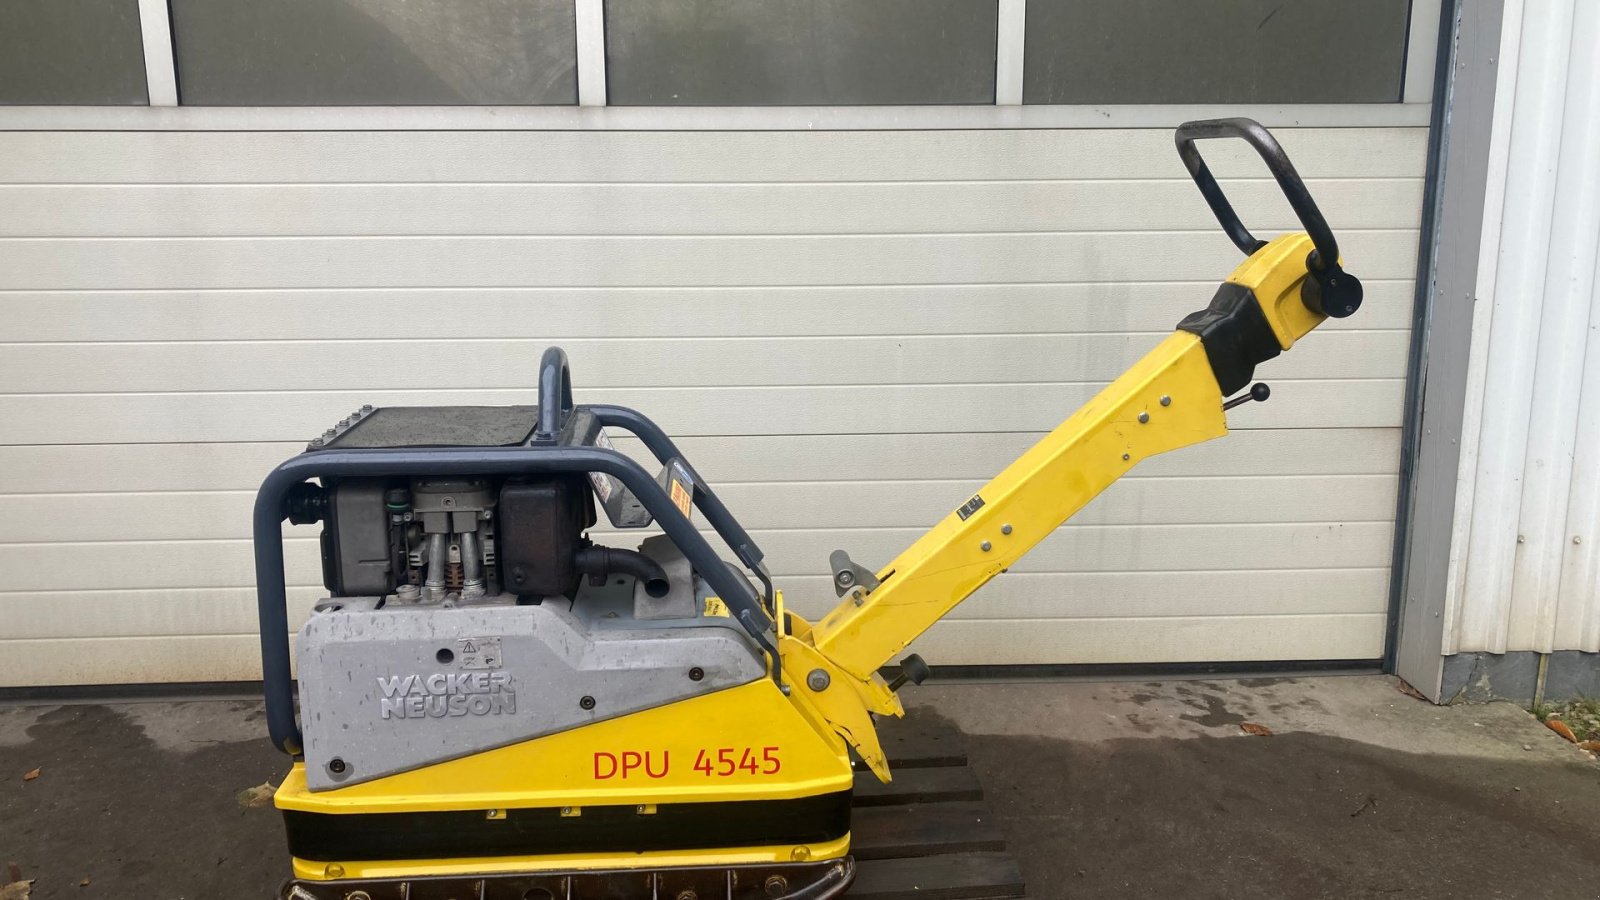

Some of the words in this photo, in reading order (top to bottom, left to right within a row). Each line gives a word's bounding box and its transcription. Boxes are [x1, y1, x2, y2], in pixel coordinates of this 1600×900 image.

[377, 671, 515, 698] WACKER
[381, 692, 517, 720] NEUSON
[594, 750, 669, 779] DPU
[693, 746, 780, 777] 4545
